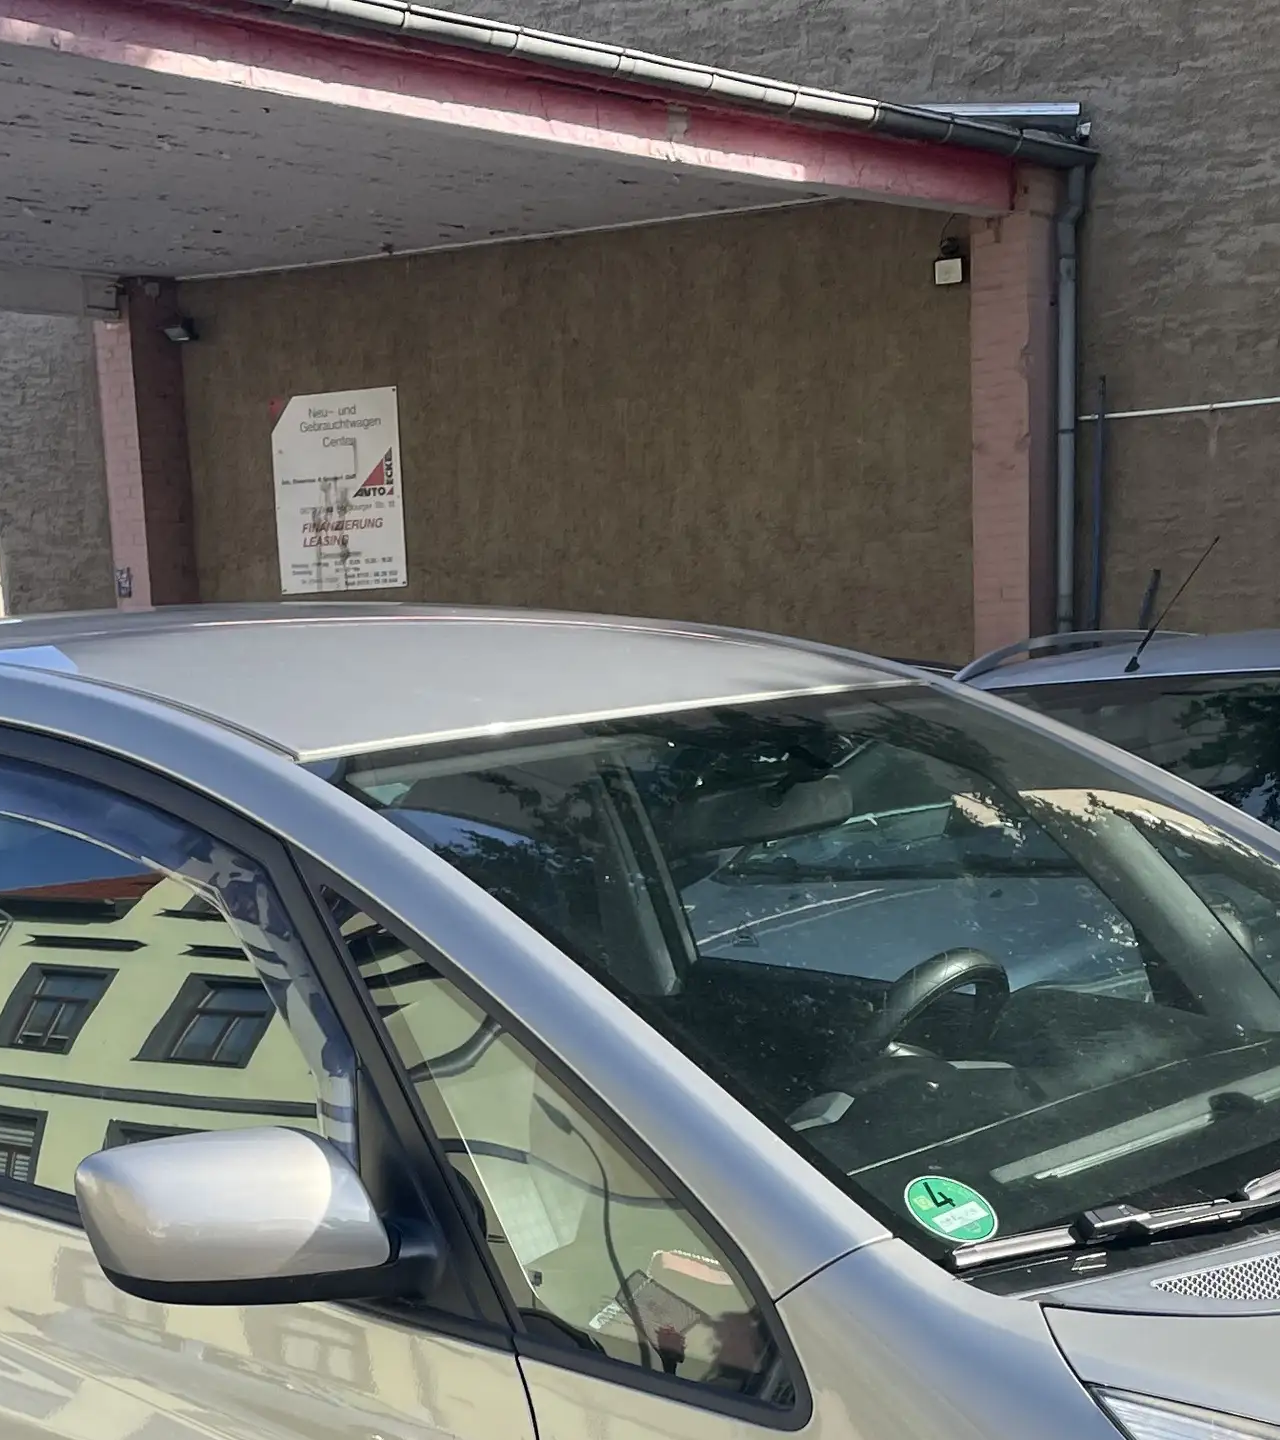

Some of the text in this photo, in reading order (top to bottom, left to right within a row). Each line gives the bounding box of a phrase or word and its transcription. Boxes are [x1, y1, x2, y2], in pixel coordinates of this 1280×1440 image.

[338, 404, 356, 416] und
[300, 417, 381, 433] Gebrauchtwagen
[353, 487, 386, 498] AUTO
[302, 518, 384, 534] FINANZIERUNG
[303, 534, 349, 548] LEASING
[922, 1181, 956, 1208] 4
